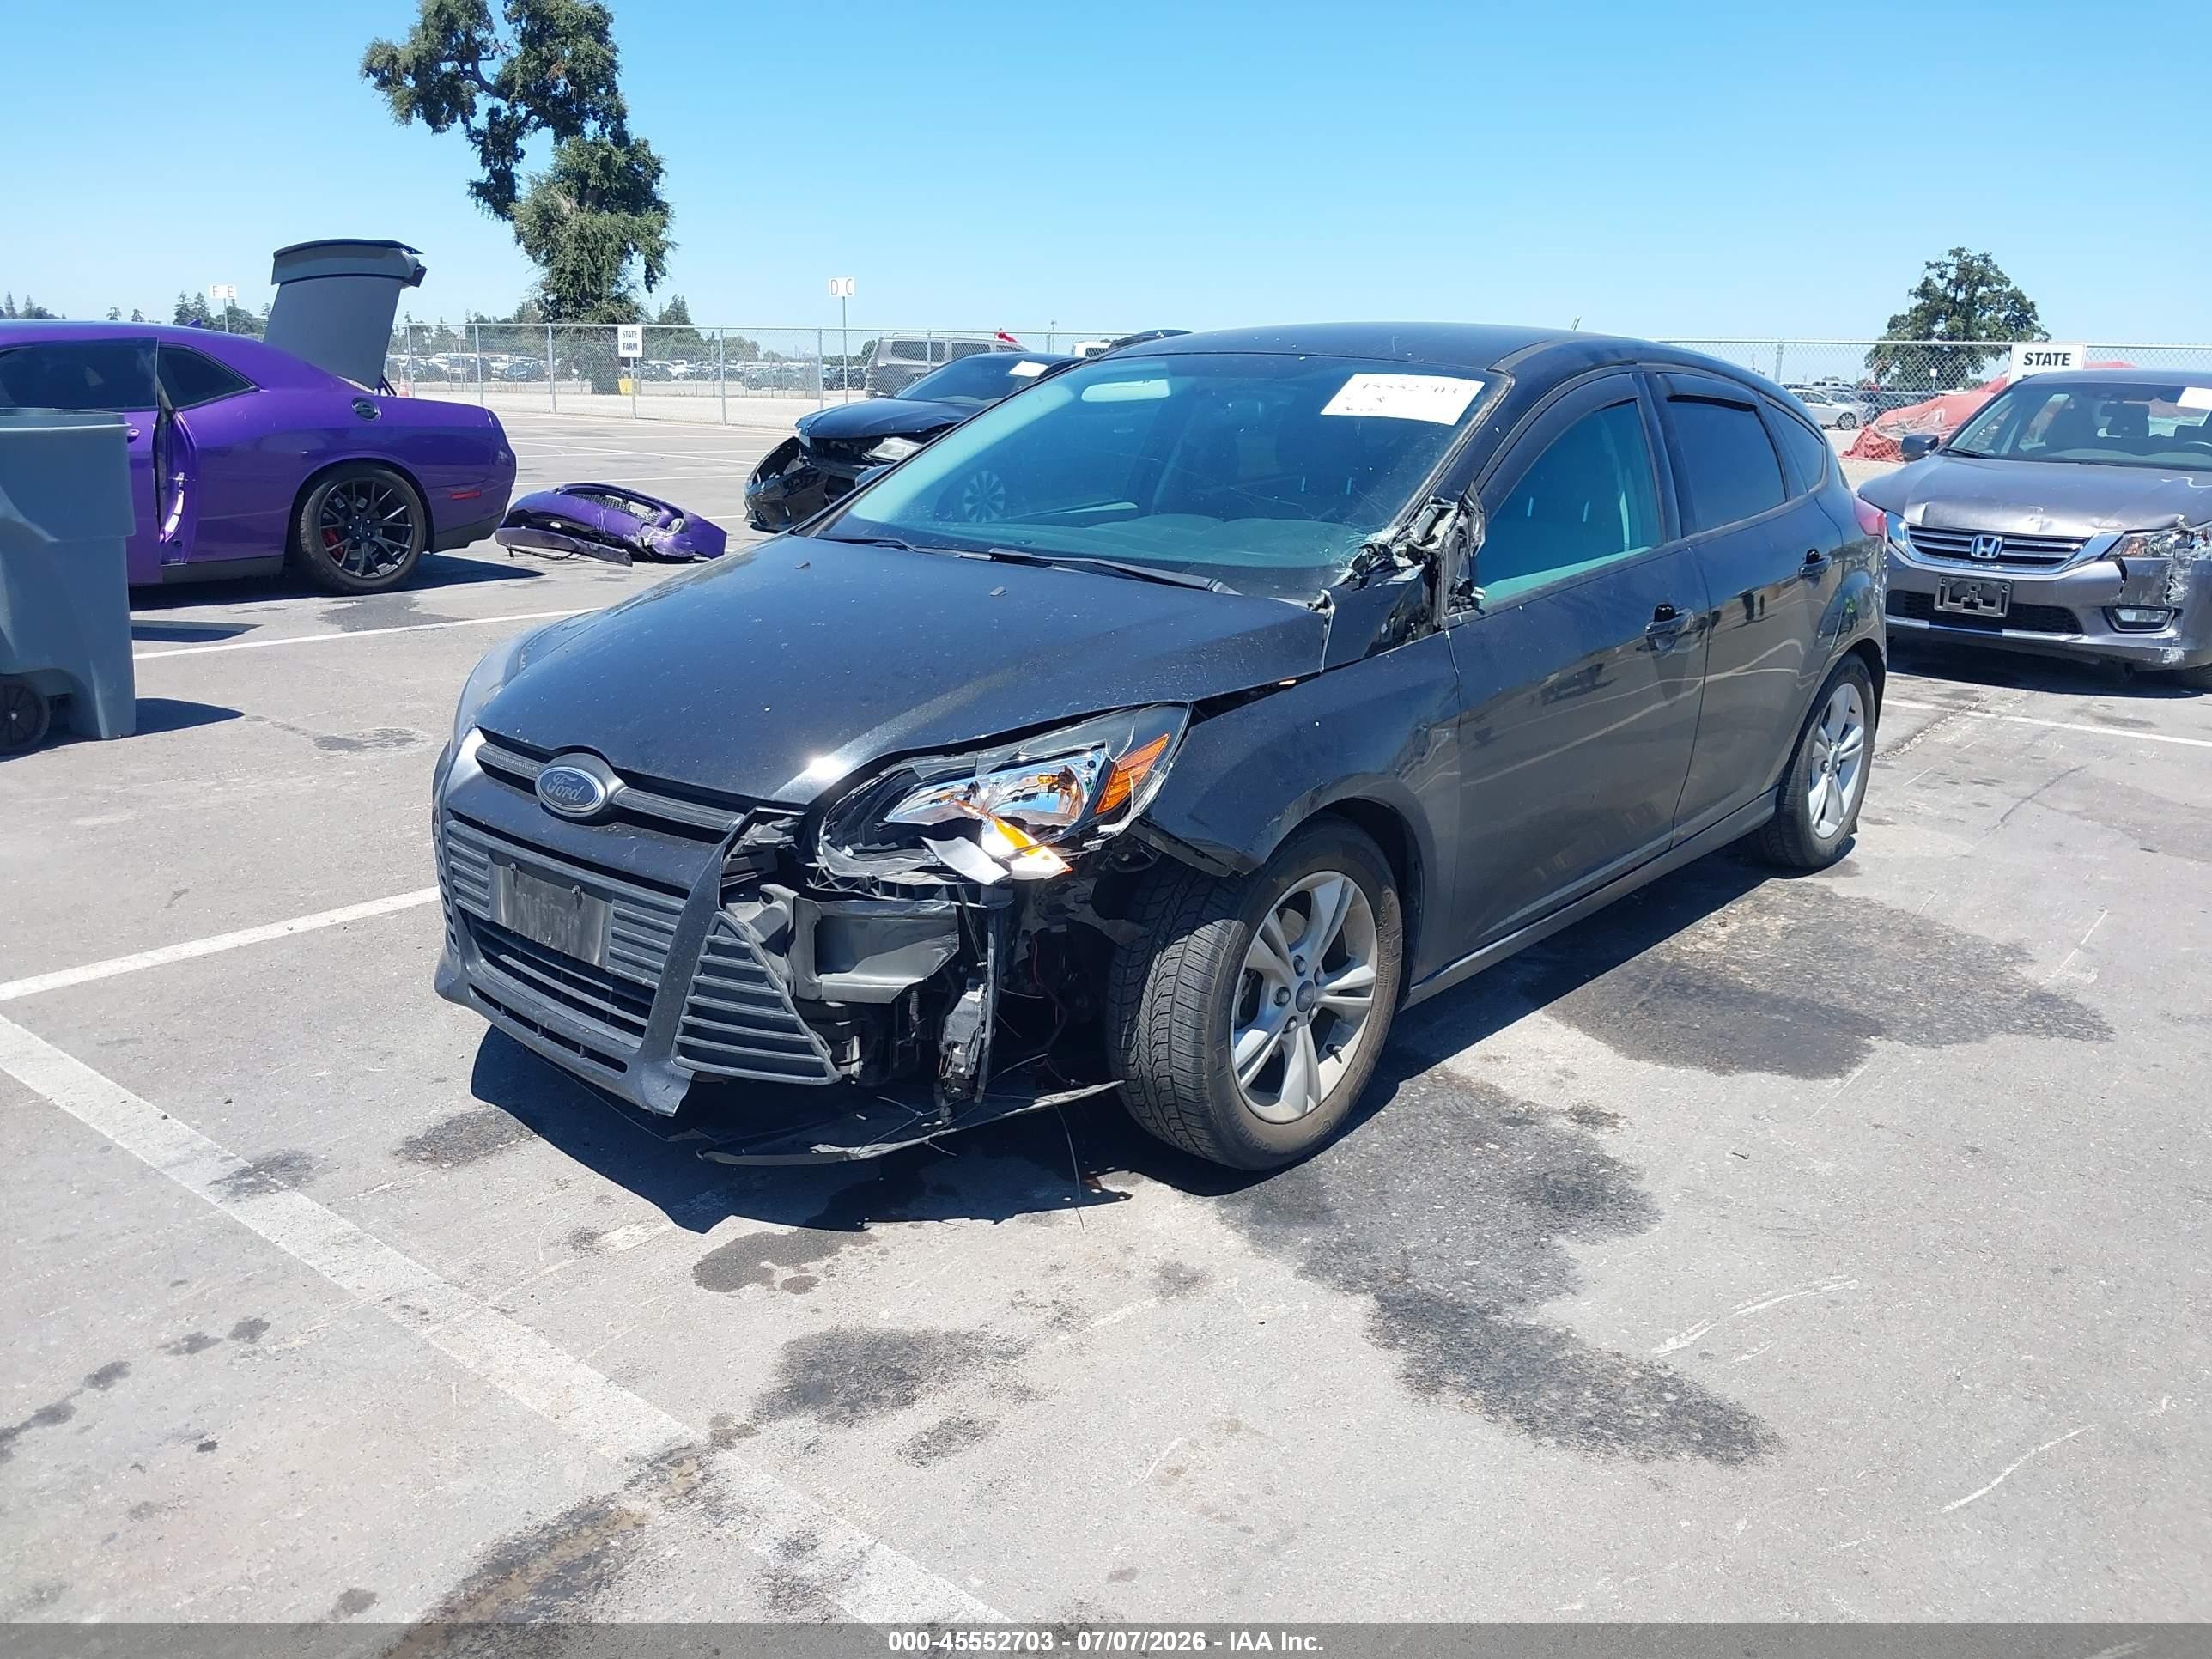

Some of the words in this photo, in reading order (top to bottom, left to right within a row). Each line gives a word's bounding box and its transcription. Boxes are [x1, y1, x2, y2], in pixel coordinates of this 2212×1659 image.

[212, 285, 220, 297] F
[830, 279, 839, 296] D
[845, 278, 853, 295] C
[622, 330, 638, 339] STATE
[623, 343, 638, 352] FARM
[2023, 352, 2071, 367] STATE
[546, 773, 585, 801] Ford
